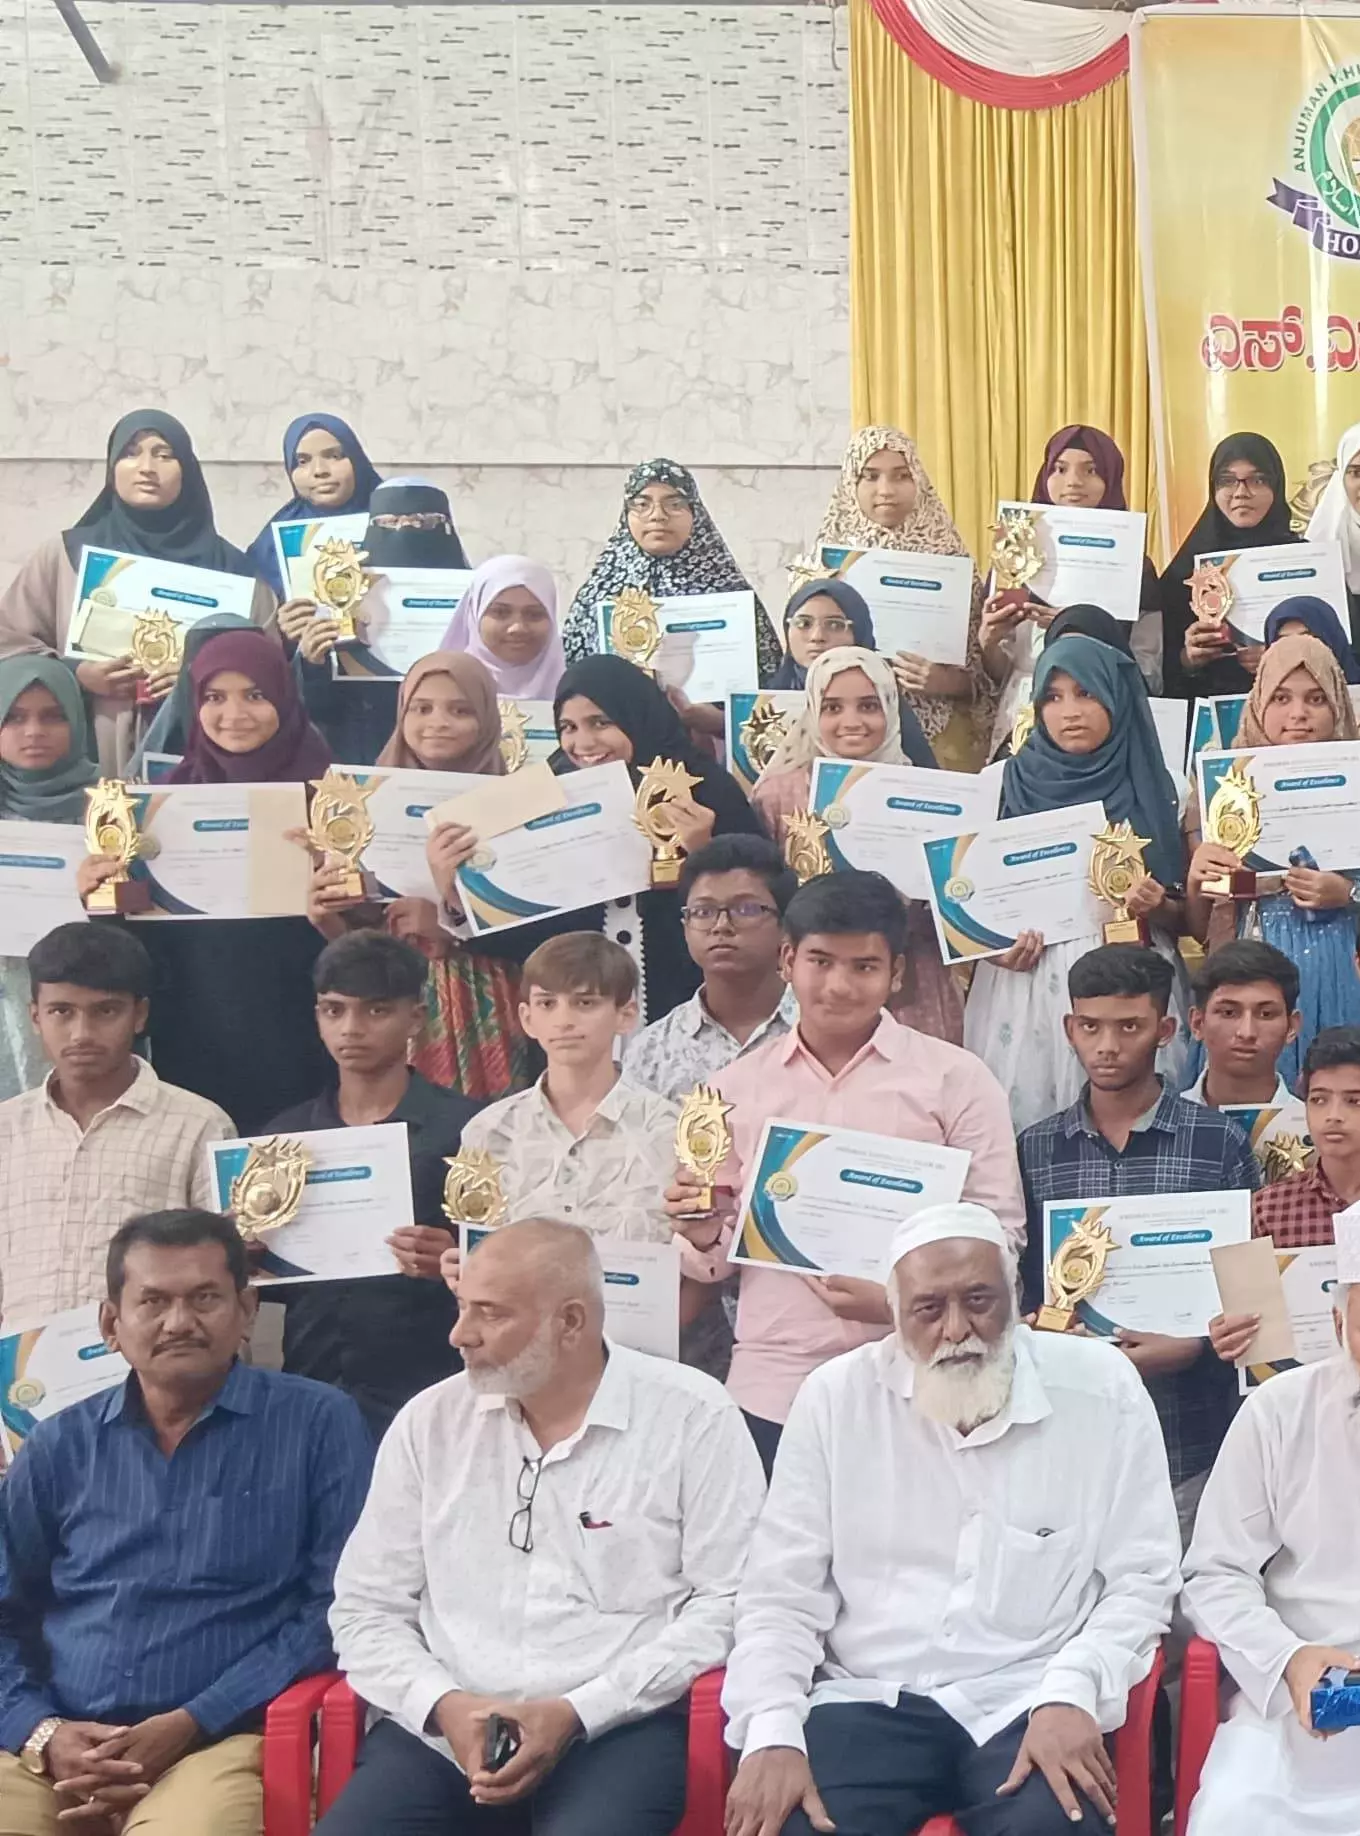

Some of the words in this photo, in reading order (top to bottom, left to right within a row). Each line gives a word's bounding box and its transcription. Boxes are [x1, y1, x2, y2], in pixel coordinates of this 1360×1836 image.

[1293, 84, 1328, 173] ANJUMAN
[1281, 779, 1302, 788] Award
[895, 800, 916, 808] Award
[1010, 851, 1031, 861] Award
[847, 1172, 871, 1183] Award
[1138, 1234, 1161, 1243] Award
